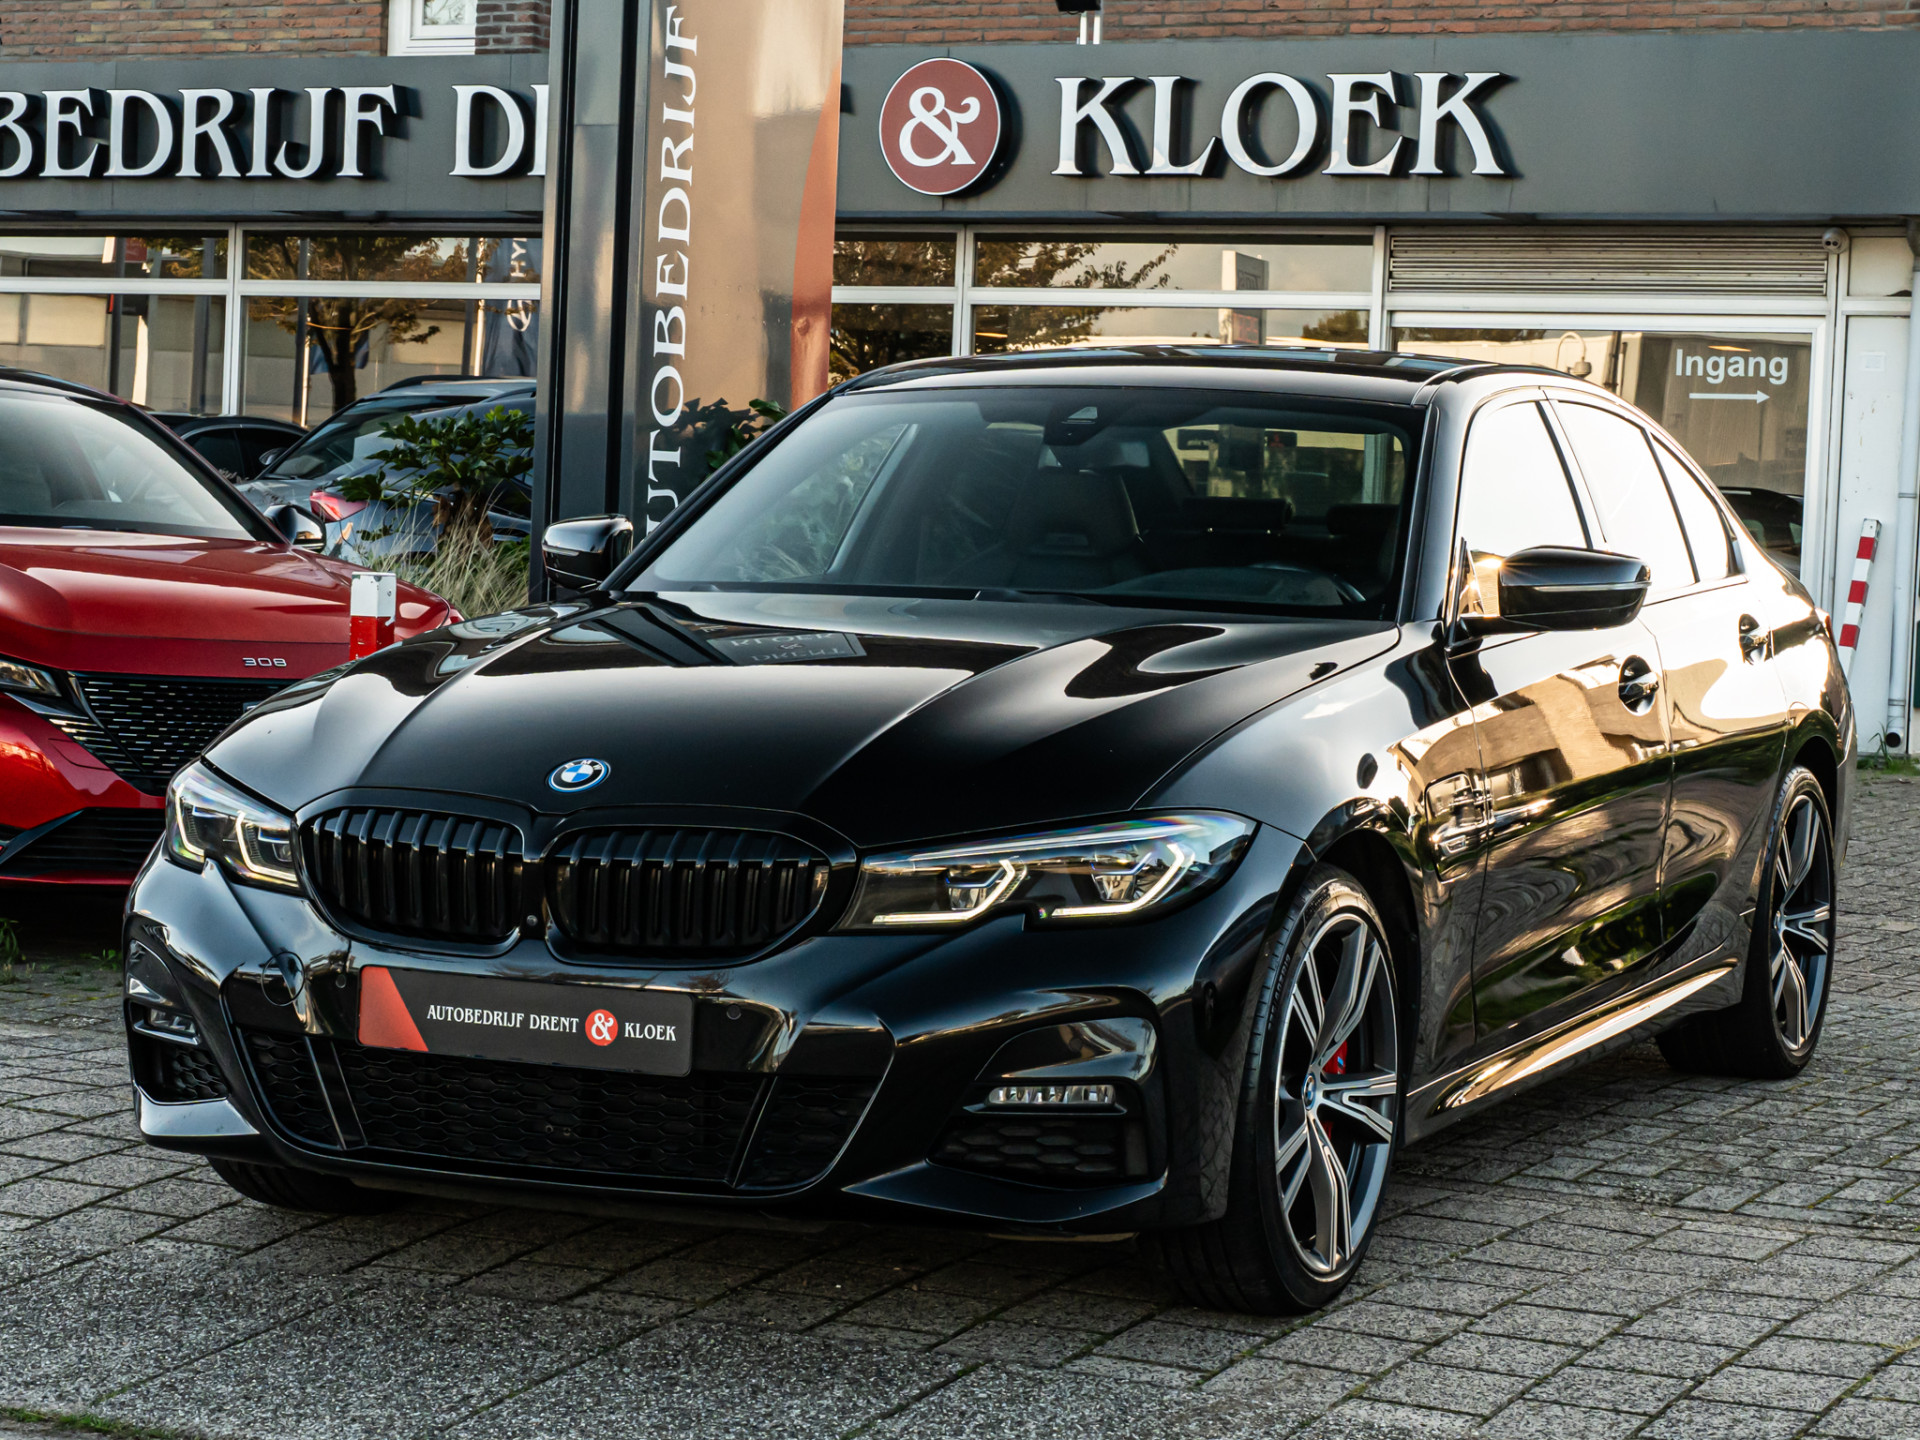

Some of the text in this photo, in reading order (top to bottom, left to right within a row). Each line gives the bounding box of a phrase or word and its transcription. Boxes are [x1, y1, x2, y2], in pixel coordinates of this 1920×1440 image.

[899, 86, 980, 167] &
[1051, 71, 1505, 177] KLOEK
[1675, 348, 1789, 385] Ingang
[242, 657, 287, 667] 308
[427, 1004, 677, 1041] AUTOBEDRIJF DRENT & KLOEK
